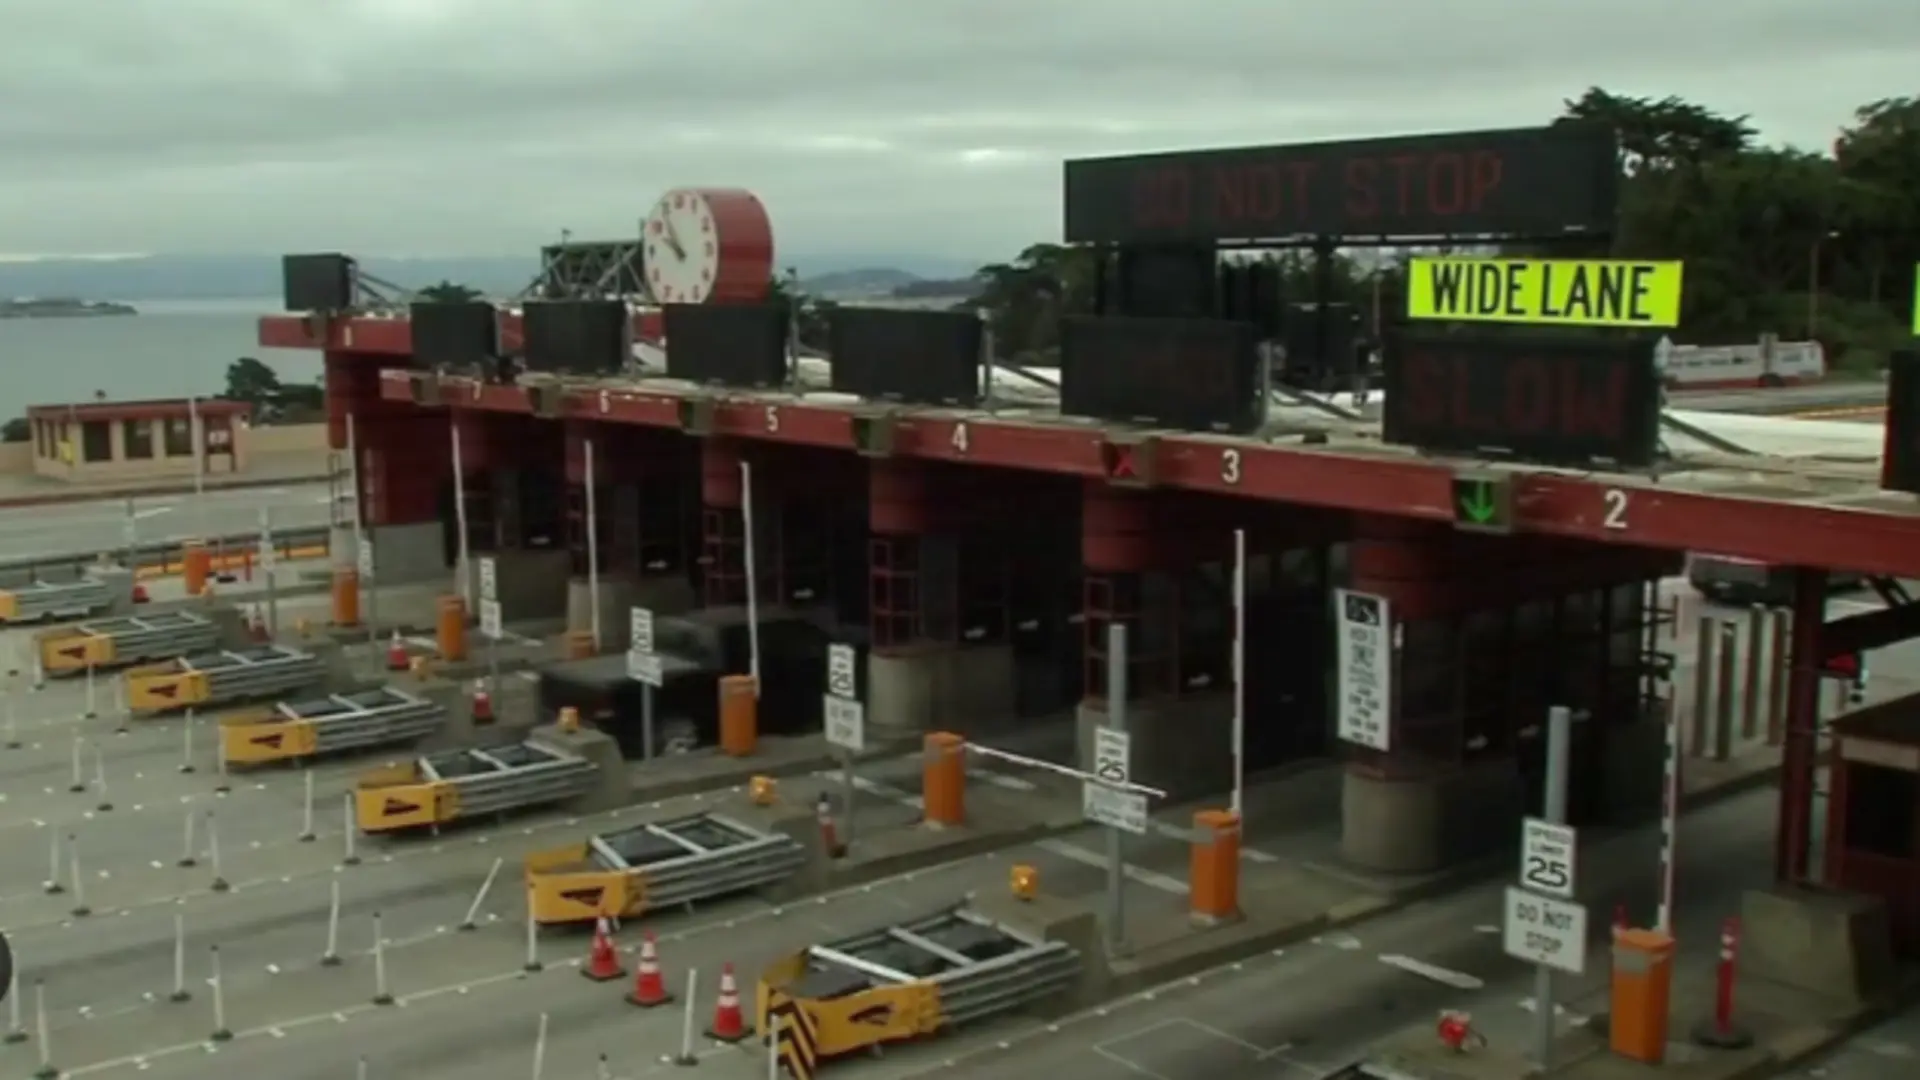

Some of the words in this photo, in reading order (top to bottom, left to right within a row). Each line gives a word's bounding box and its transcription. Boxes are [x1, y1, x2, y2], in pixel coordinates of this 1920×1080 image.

[1133, 167, 1190, 227] DO
[1213, 160, 1318, 221] NOT
[1345, 150, 1504, 218] STOP
[1431, 263, 1528, 315] WIDE
[1539, 264, 1655, 320] LANE
[1406, 356, 1628, 435] SLOW
[767, 406, 778, 432] 5
[951, 422, 968, 452] 4
[1221, 448, 1241, 484] 3
[1603, 489, 1628, 529] 2
[1526, 855, 1569, 888] 25
[1542, 910, 1575, 932] NOT
